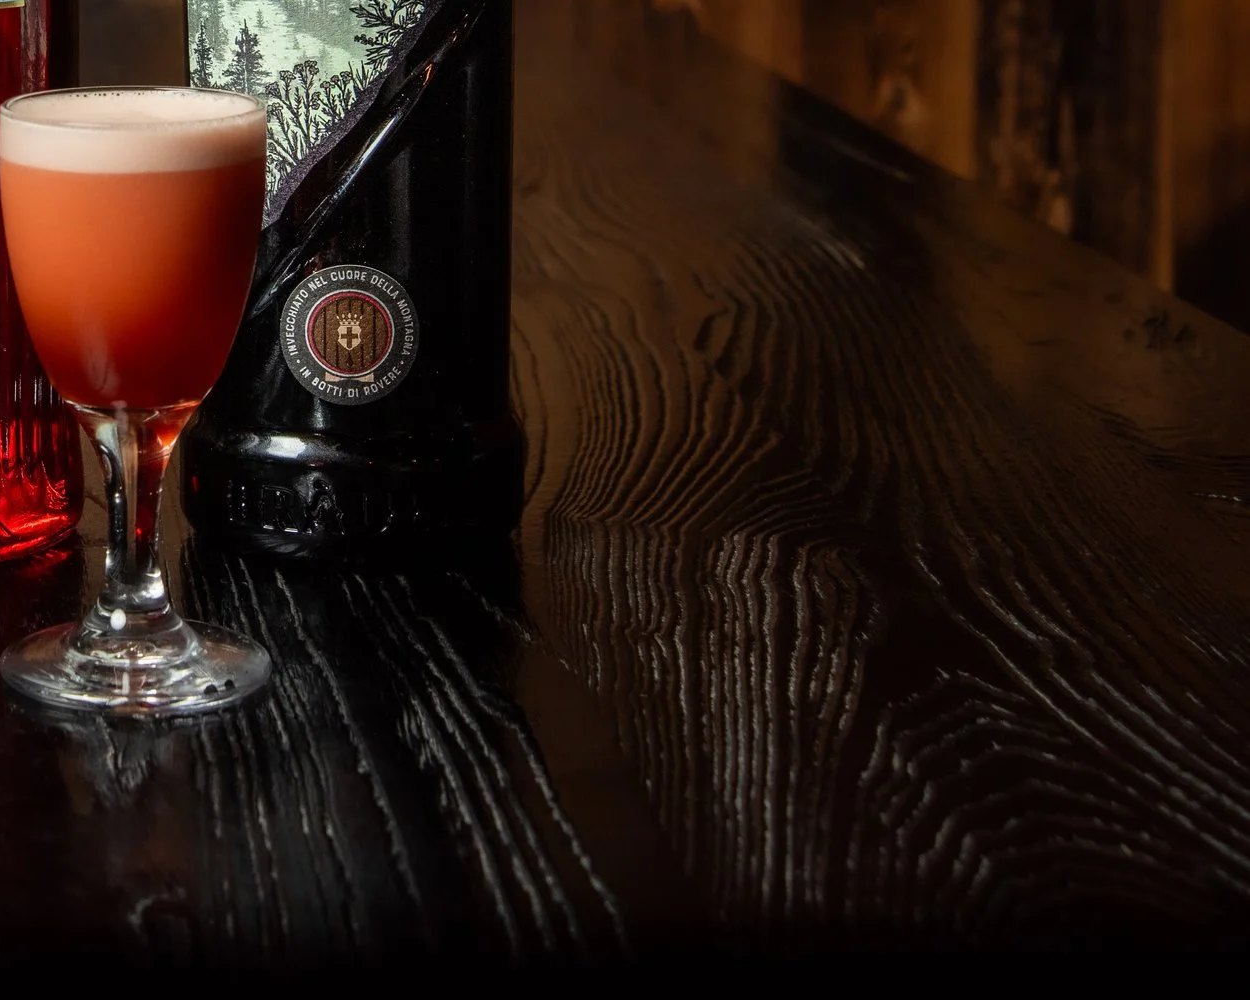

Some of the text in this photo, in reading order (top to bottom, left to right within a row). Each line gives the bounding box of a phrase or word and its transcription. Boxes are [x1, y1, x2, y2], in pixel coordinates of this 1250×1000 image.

[285, 270, 414, 356] INVECCHIATO NEL CUORE DELLA MONTAGNA
[299, 365, 402, 398] IN BOTTI DI ROVERE
